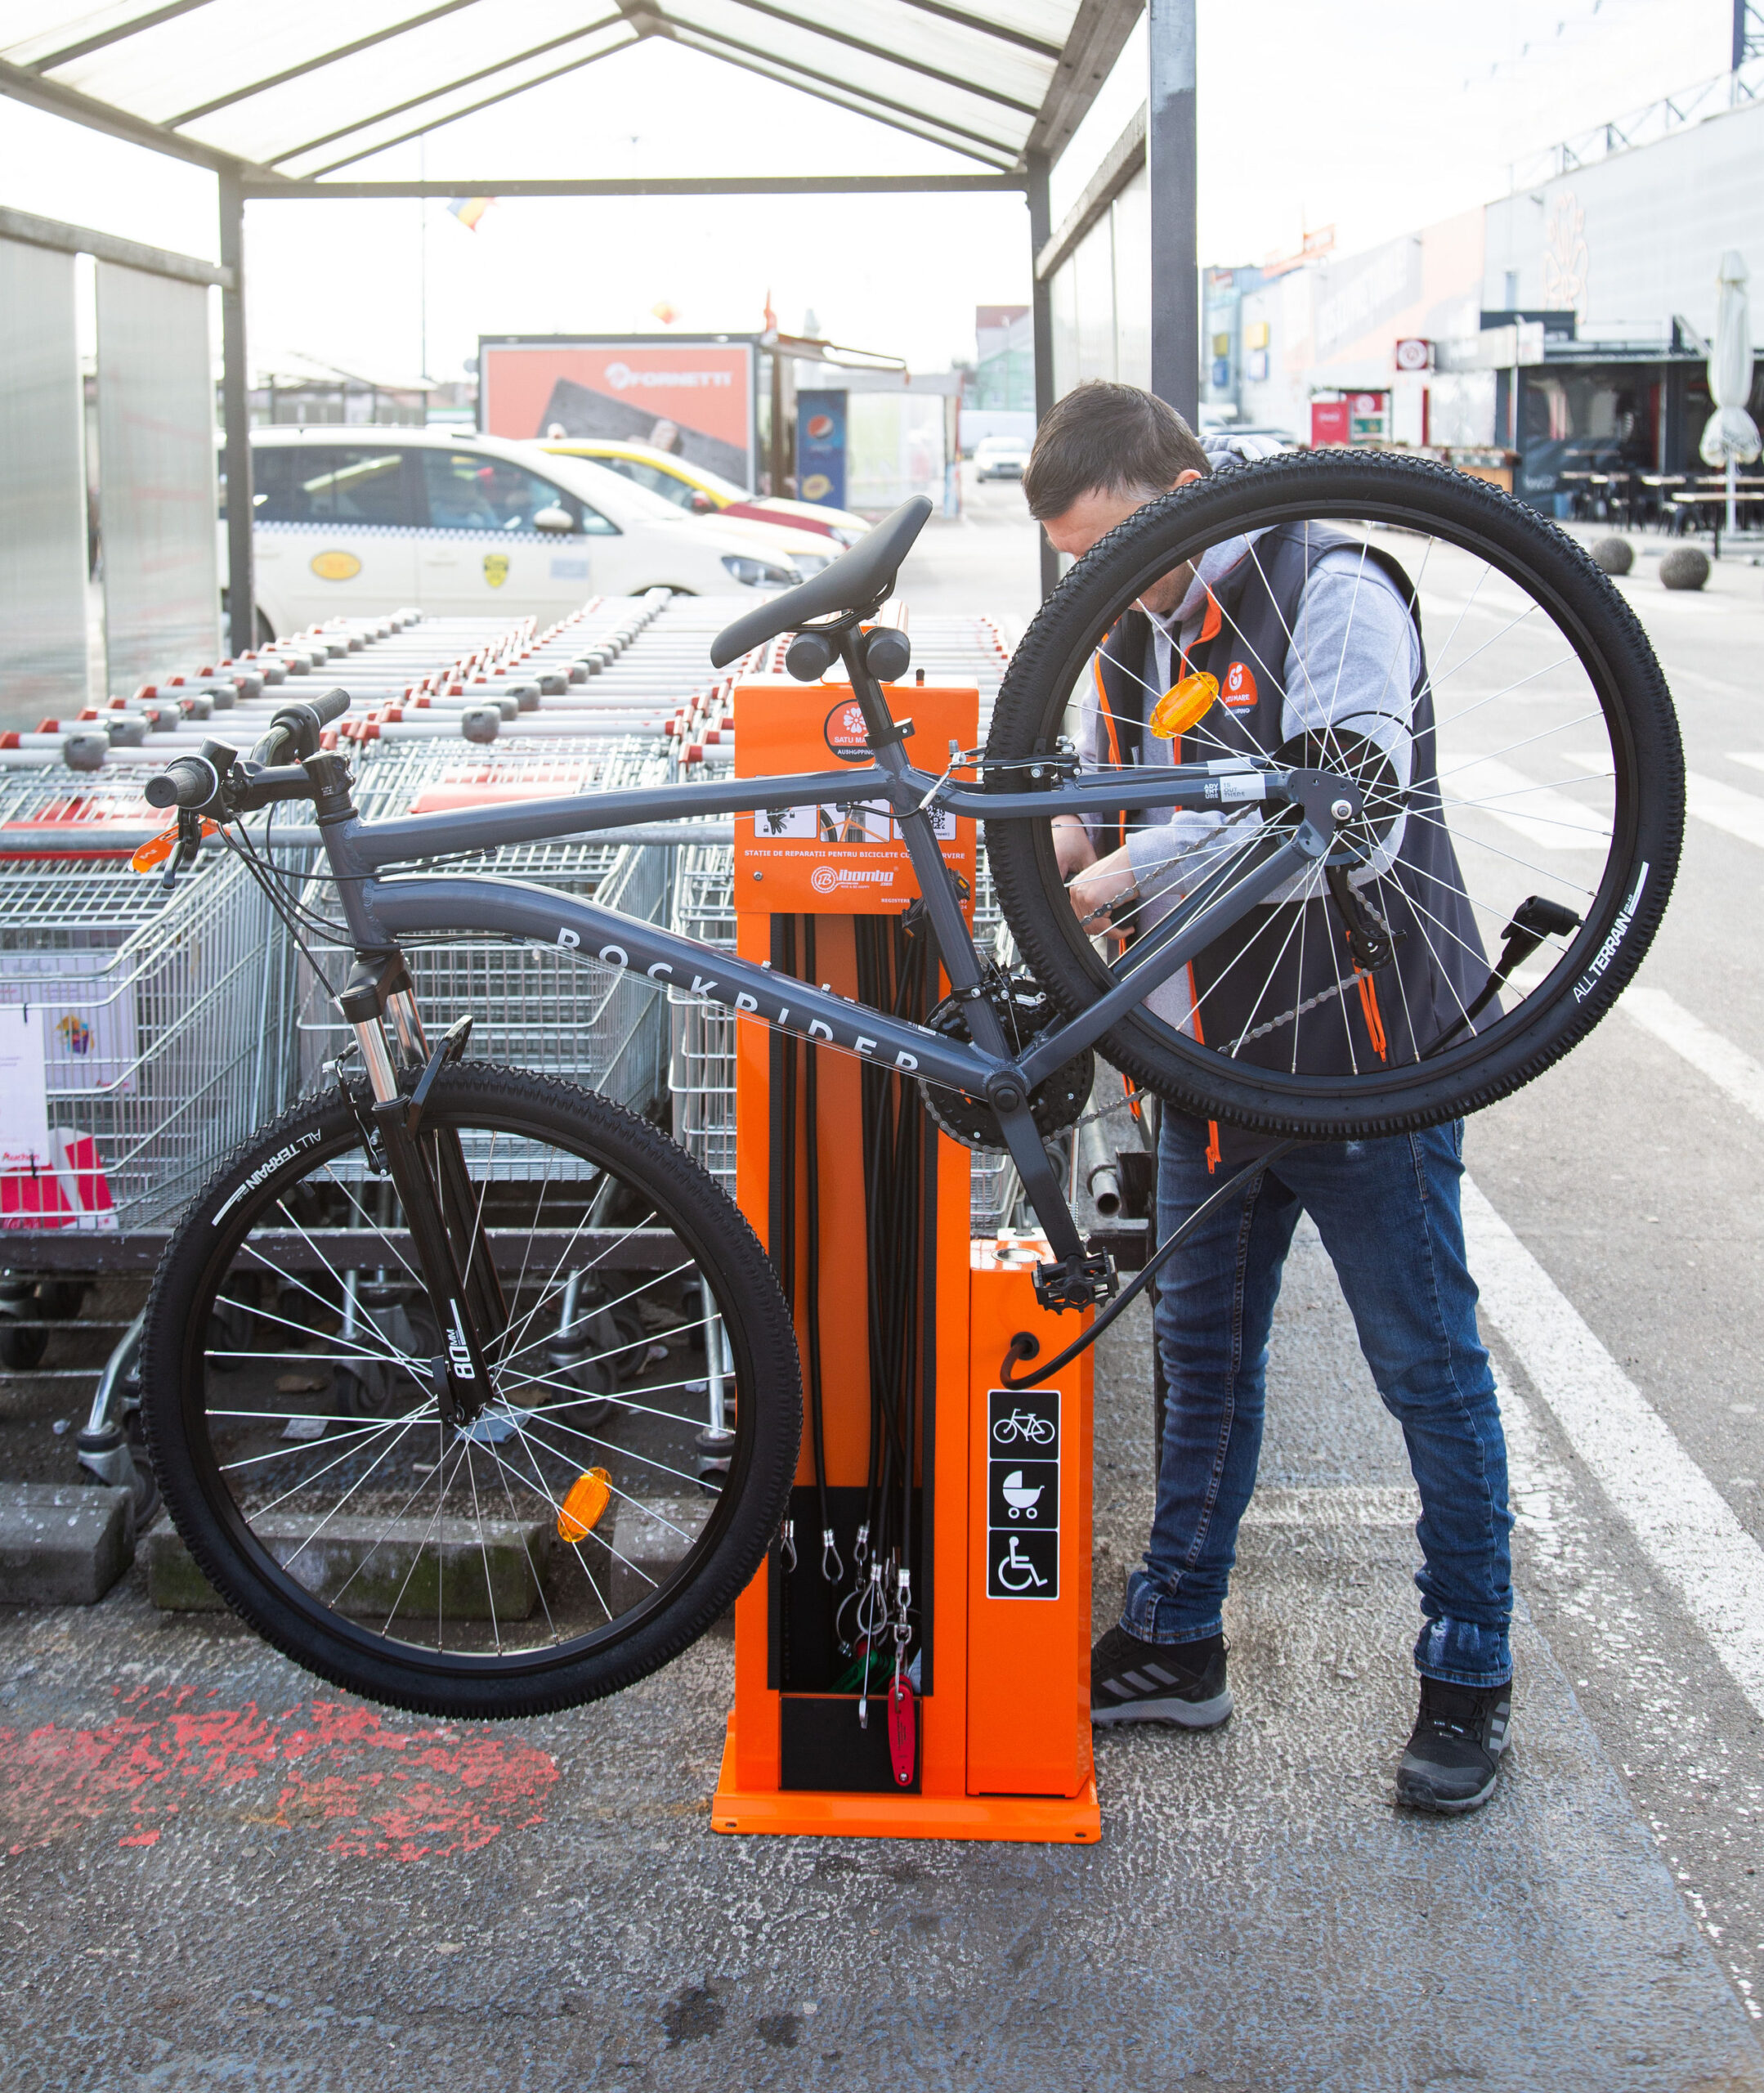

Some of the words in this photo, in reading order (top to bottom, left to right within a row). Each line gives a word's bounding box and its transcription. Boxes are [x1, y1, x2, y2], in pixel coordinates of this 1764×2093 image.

[629, 371, 732, 388] FORNETTI
[1573, 976, 1597, 1004] ALL
[1588, 911, 1632, 976] TERRAIN
[296, 1128, 321, 1148] ALL
[245, 1144, 301, 1190] TERRAIN
